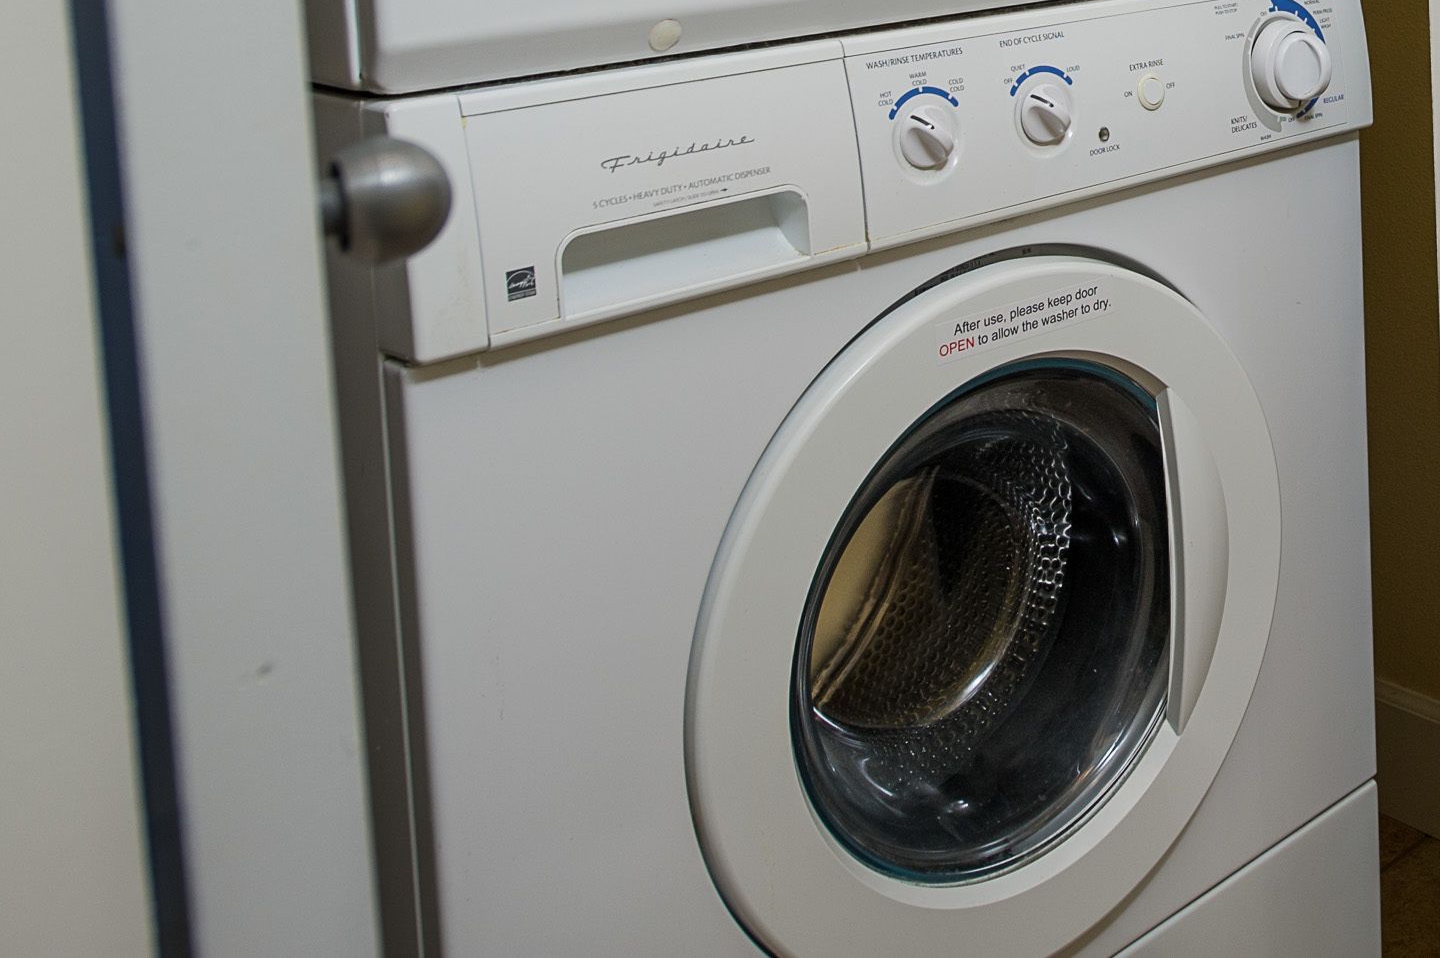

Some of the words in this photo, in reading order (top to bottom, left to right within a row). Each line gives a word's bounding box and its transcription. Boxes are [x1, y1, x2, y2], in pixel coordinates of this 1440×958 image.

[1000, 40, 1013, 48] END
[1014, 38, 1022, 46] OF
[1023, 35, 1042, 44] CYCLE
[1042, 31, 1064, 41] SIGNAL
[866, 56, 910, 70] WASH/RINSE
[911, 47, 963, 62] TEMPERATURES
[1010, 64, 1025, 72] QUIET
[1129, 62, 1148, 72] EXTRA
[1148, 58, 1164, 68] RINSE
[912, 78, 927, 86] COLD
[948, 78, 963, 86] COLD
[1166, 82, 1175, 90] OFF
[880, 90, 892, 98] HOT
[950, 85, 964, 93] COLD
[878, 98, 894, 107] COLD
[1323, 94, 1344, 104] REGULAR
[1230, 115, 1248, 124] KNITS/
[1231, 122, 1258, 134] DELICATES
[600, 136, 754, 173] Frigidaire
[1090, 147, 1106, 156] DOOR
[1106, 144, 1120, 152] LOCK
[600, 195, 628, 208] CYCLES
[633, 188, 660, 202] HEAVY
[660, 184, 683, 196] DUTY
[688, 174, 734, 190] AUTOMATIC
[734, 166, 771, 180] DISPENSER
[954, 320, 980, 336] After
[984, 314, 1007, 326] use,
[1010, 301, 1045, 324] please
[1048, 294, 1073, 308] keep
[1075, 285, 1098, 300] door
[939, 337, 975, 358] OPEN
[978, 334, 988, 346] to
[991, 326, 1019, 342] allow
[1022, 319, 1038, 332] the
[1041, 307, 1079, 326] washer
[1080, 304, 1091, 316] to
[1093, 297, 1112, 312] dry.
